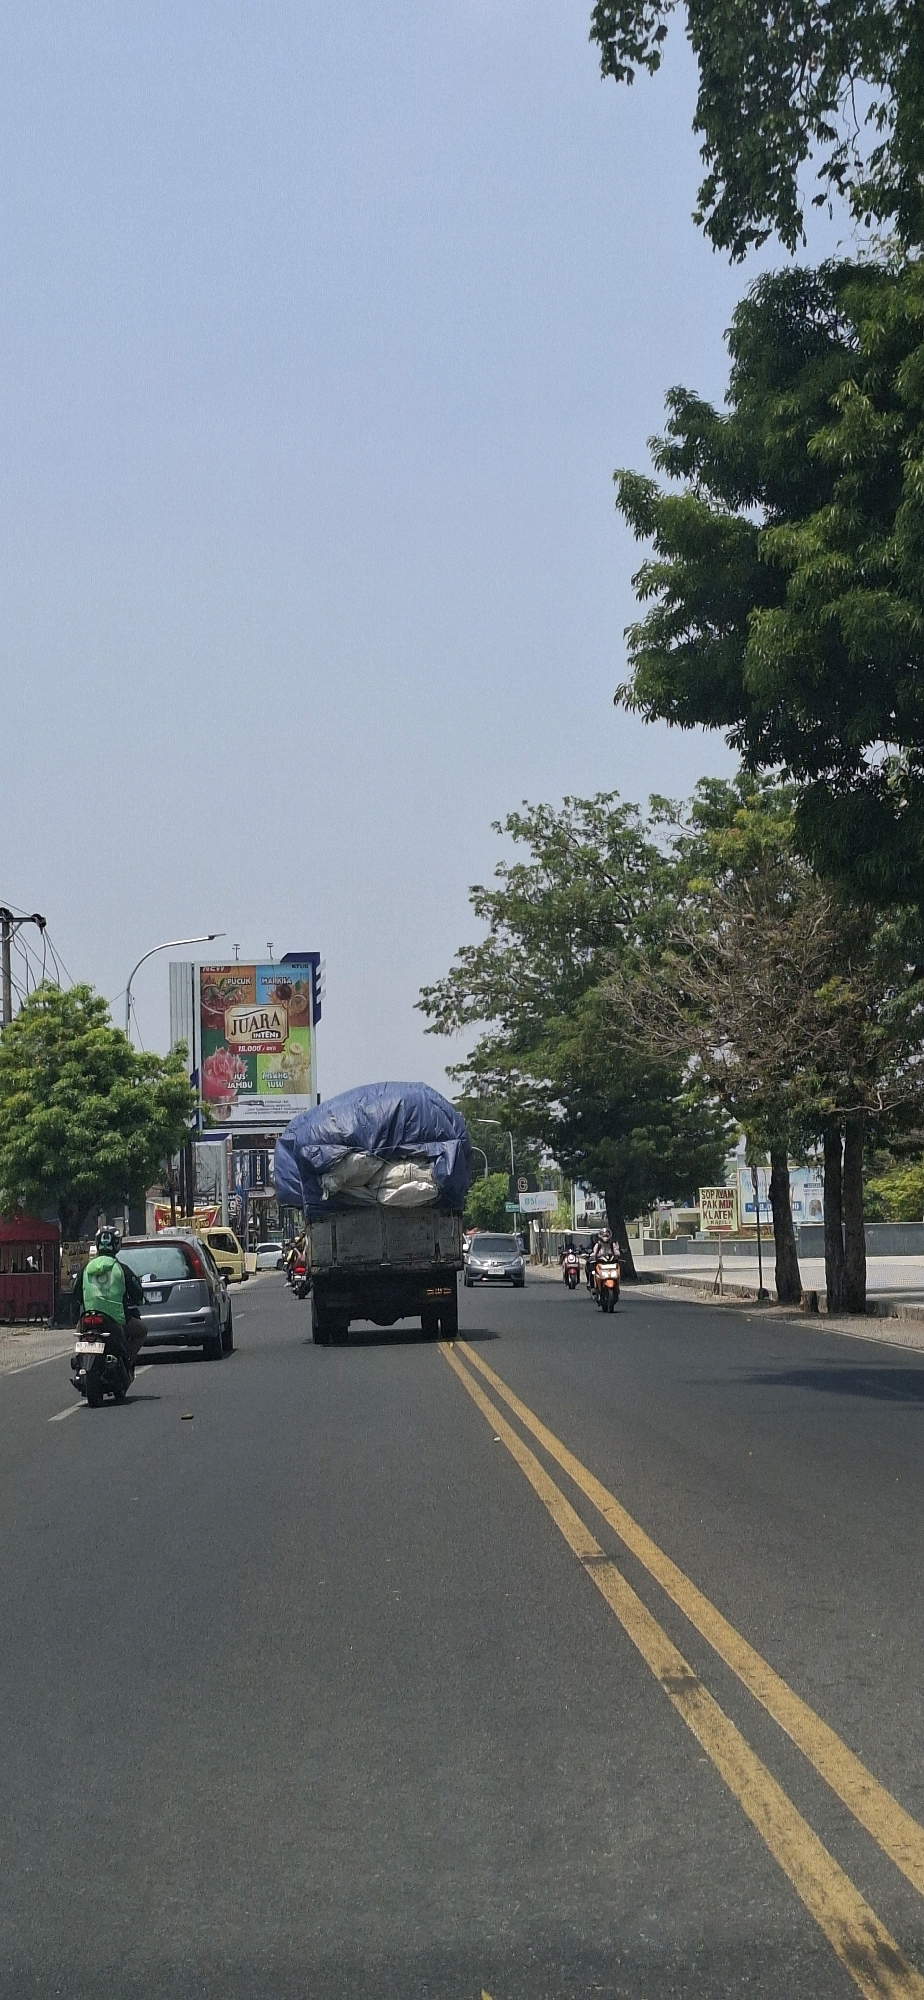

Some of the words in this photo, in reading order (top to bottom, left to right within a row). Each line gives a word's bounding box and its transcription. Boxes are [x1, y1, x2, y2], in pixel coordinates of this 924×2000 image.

[227, 977, 252, 985] PUCUK
[231, 1011, 280, 1035] JUARA
[227, 1081, 253, 1089] JAMBU
[517, 1177, 528, 1192] G
[701, 1189, 715, 1199] SOP
[716, 1189, 734, 1199] AYAM
[702, 1200, 718, 1209] PAK
[719, 1200, 734, 1209] MIN
[703, 1210, 733, 1220] KLATEN
